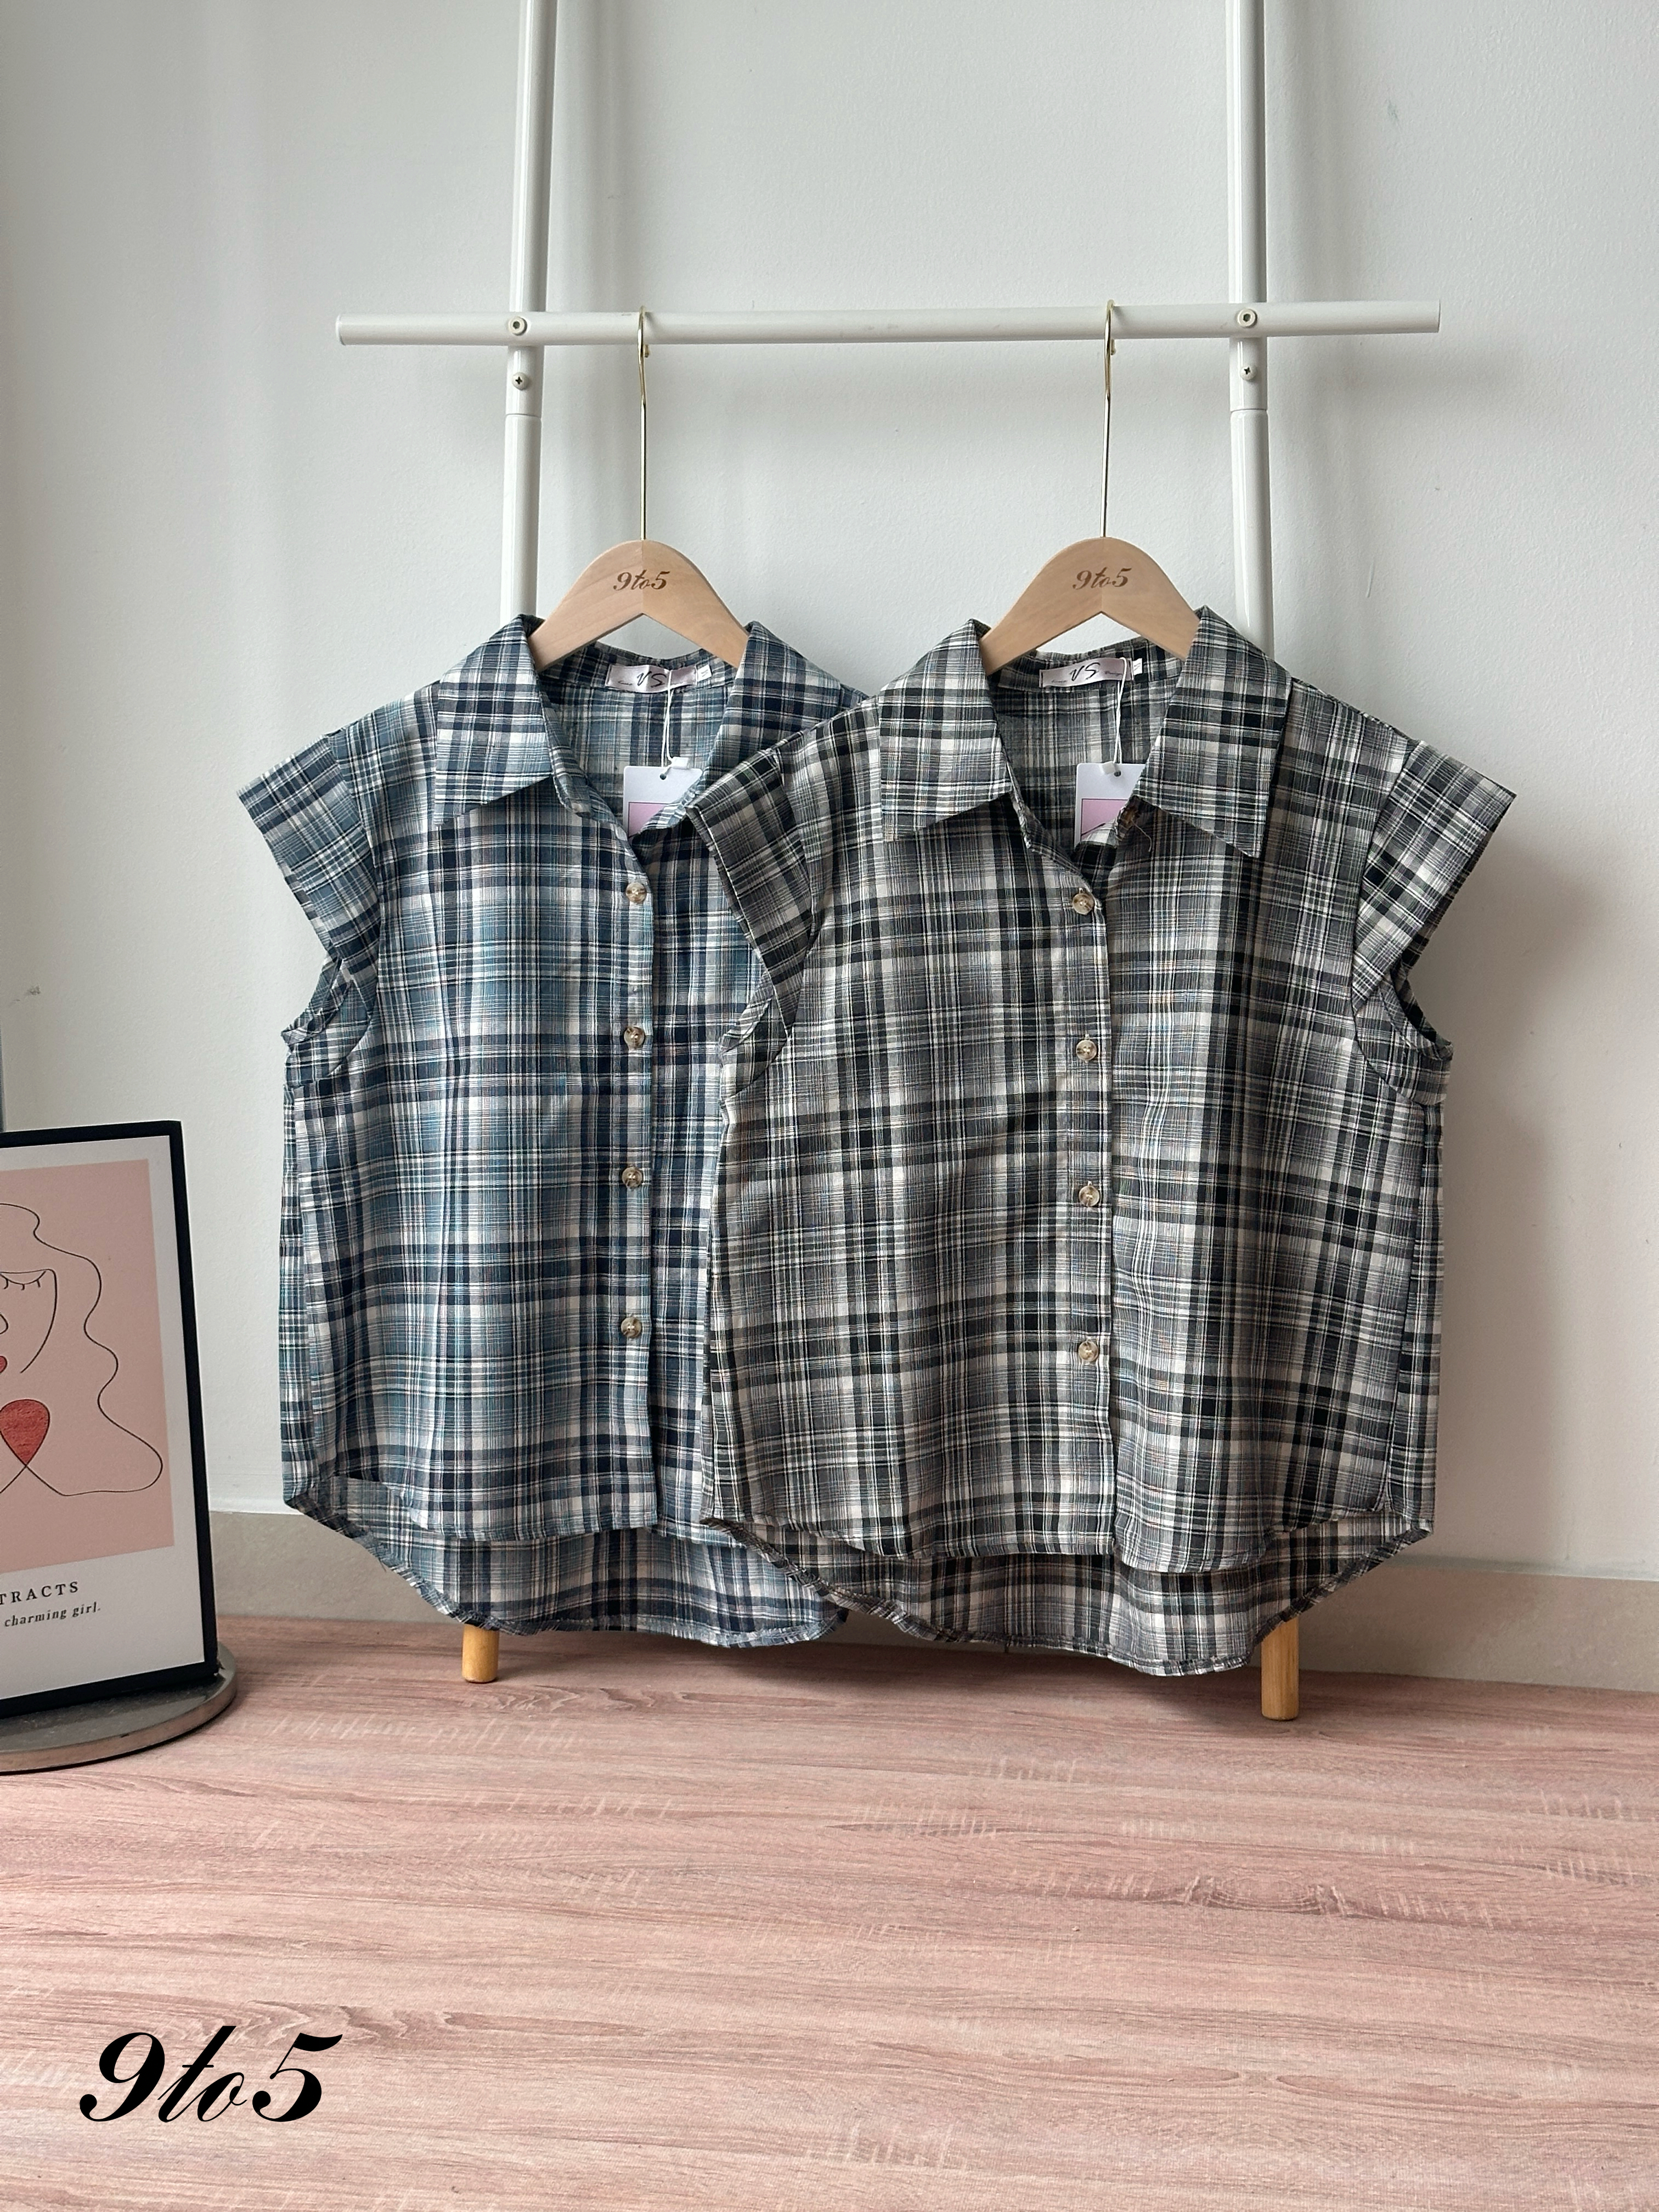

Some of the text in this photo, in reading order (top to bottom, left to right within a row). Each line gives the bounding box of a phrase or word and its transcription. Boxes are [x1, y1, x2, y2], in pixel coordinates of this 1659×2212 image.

[613, 569, 670, 591] 9to5
[1073, 567, 1132, 590] 9to5
[4, 1601, 100, 1627] charming girl.
